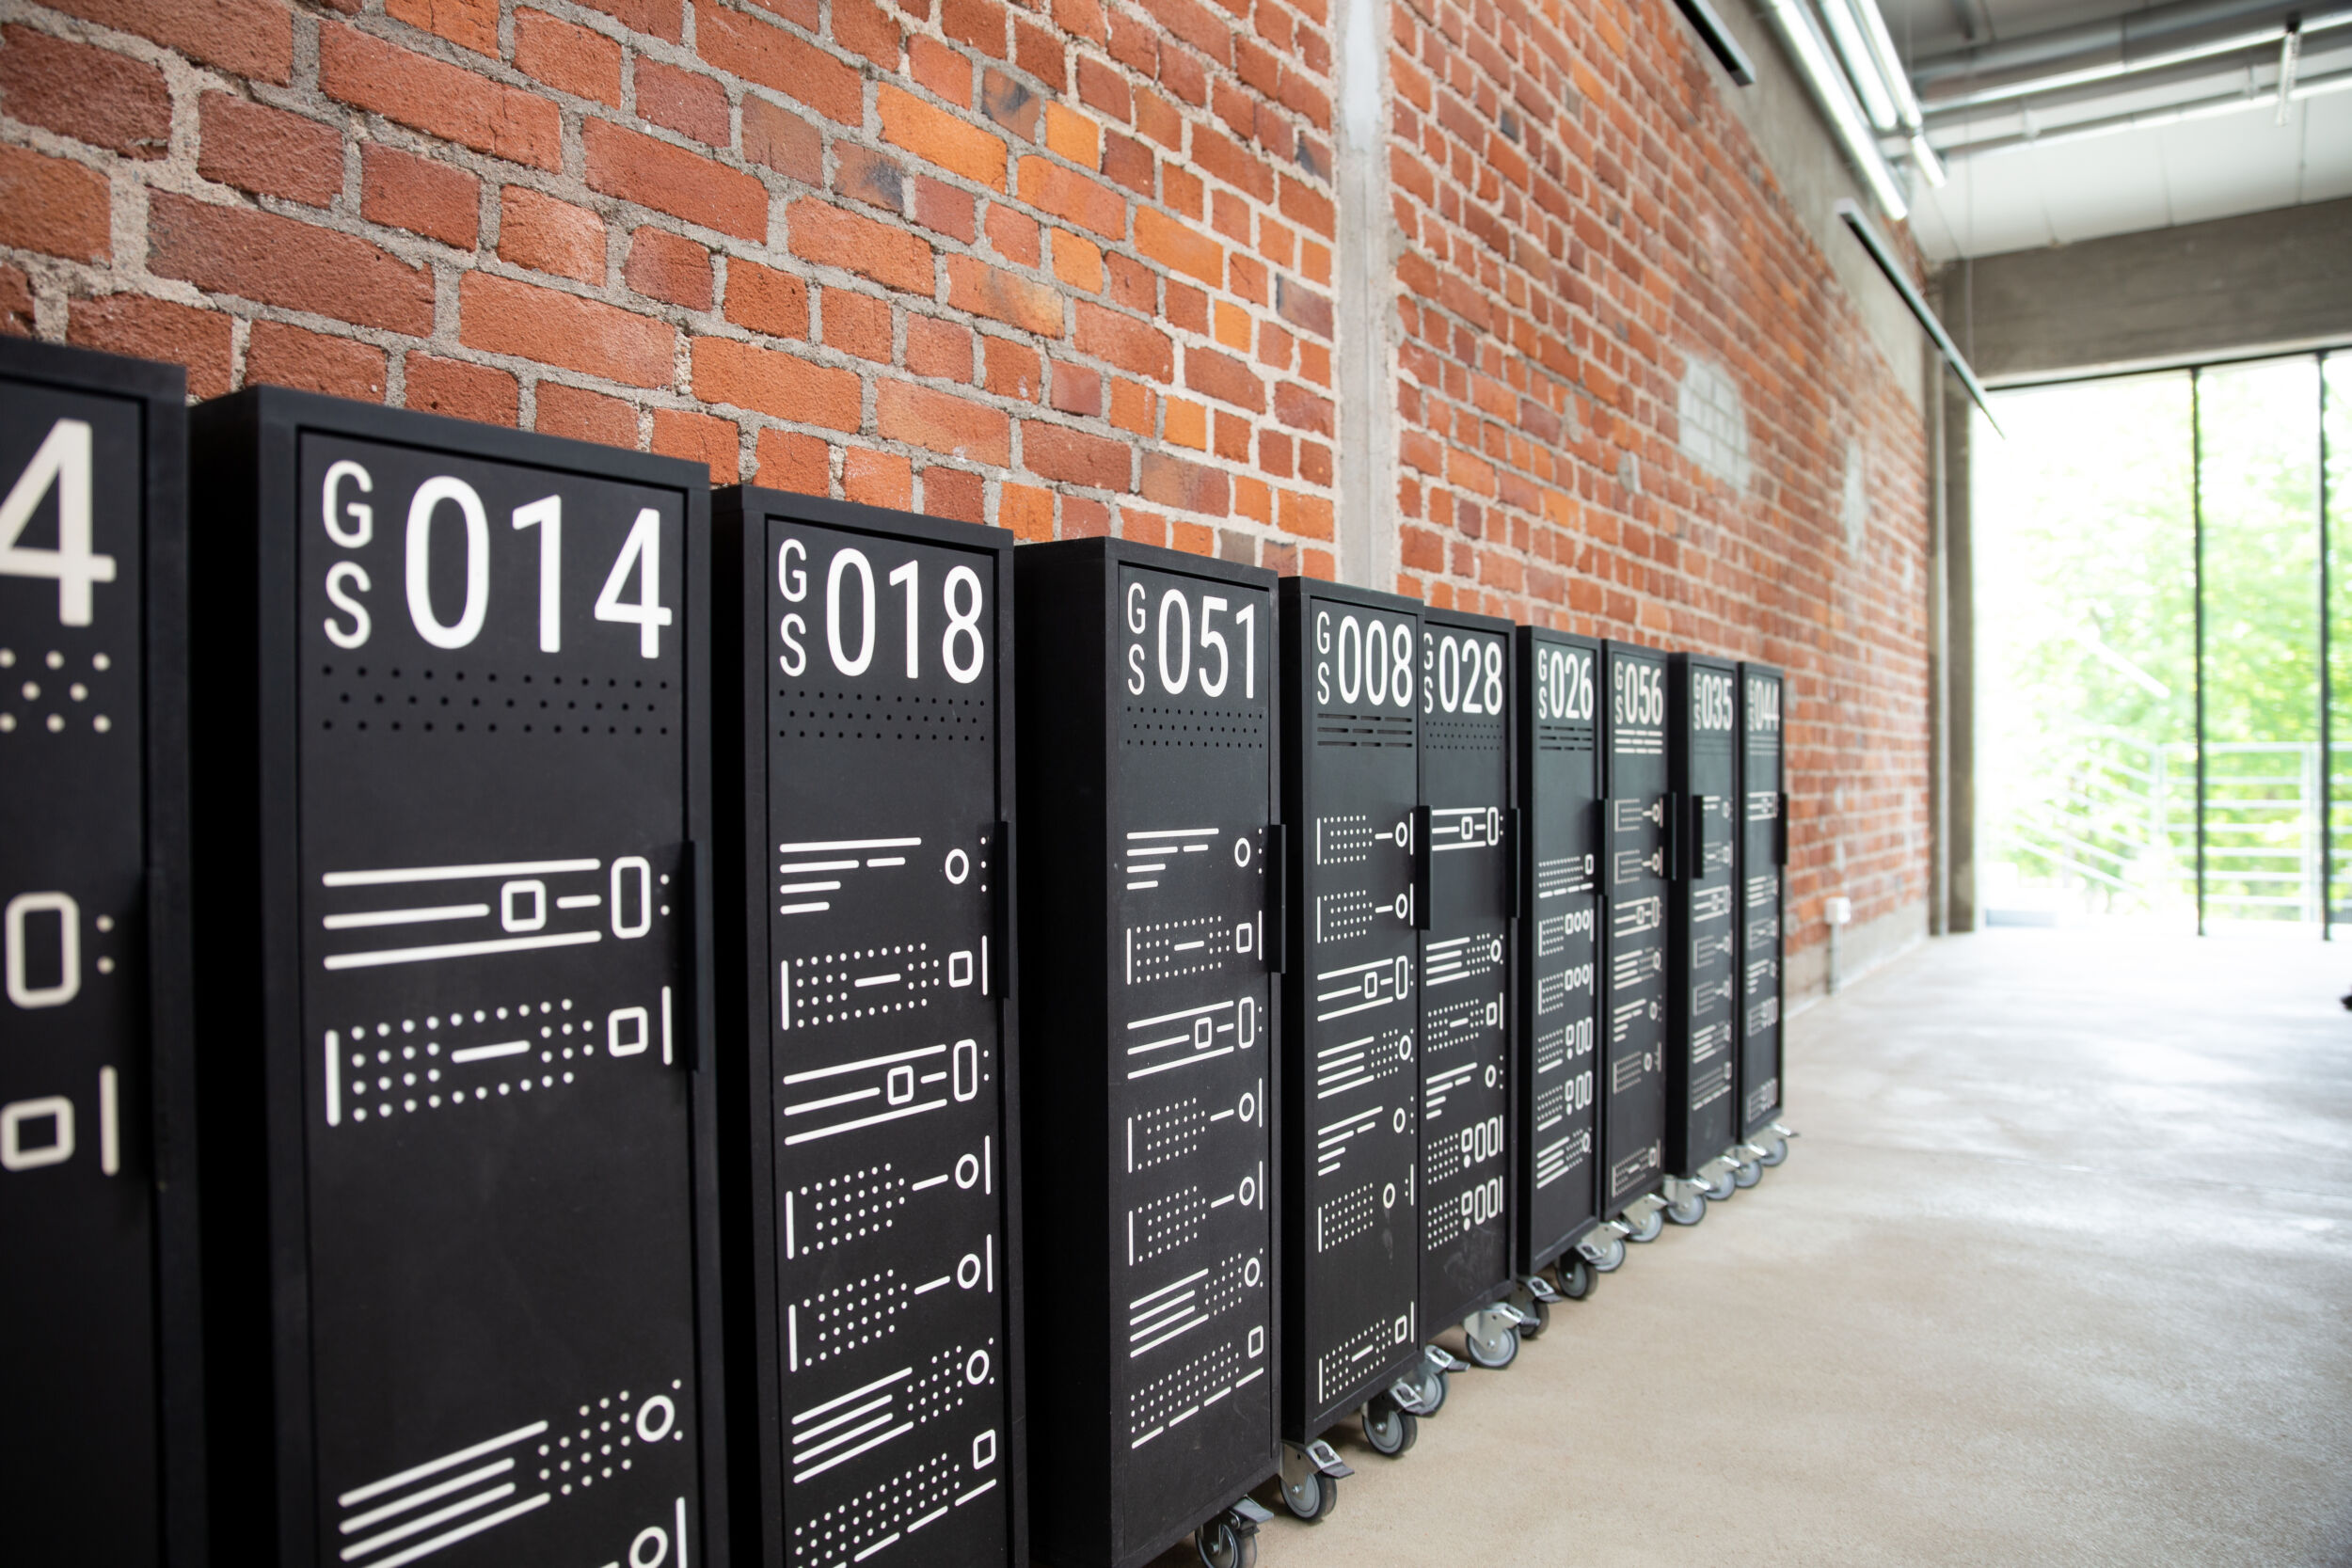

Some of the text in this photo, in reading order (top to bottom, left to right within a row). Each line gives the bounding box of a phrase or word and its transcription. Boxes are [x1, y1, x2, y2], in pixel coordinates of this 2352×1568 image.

[405, 476, 672, 658] 014
[827, 547, 984, 684] 018
[1158, 589, 1254, 699] 051
[1338, 615, 1413, 707] 008
[1438, 635, 1502, 716] 028
[1549, 651, 1594, 721] 026
[1625, 662, 1663, 725] 056
[1701, 674, 1734, 731] 035
[1755, 680, 1780, 731] 044
